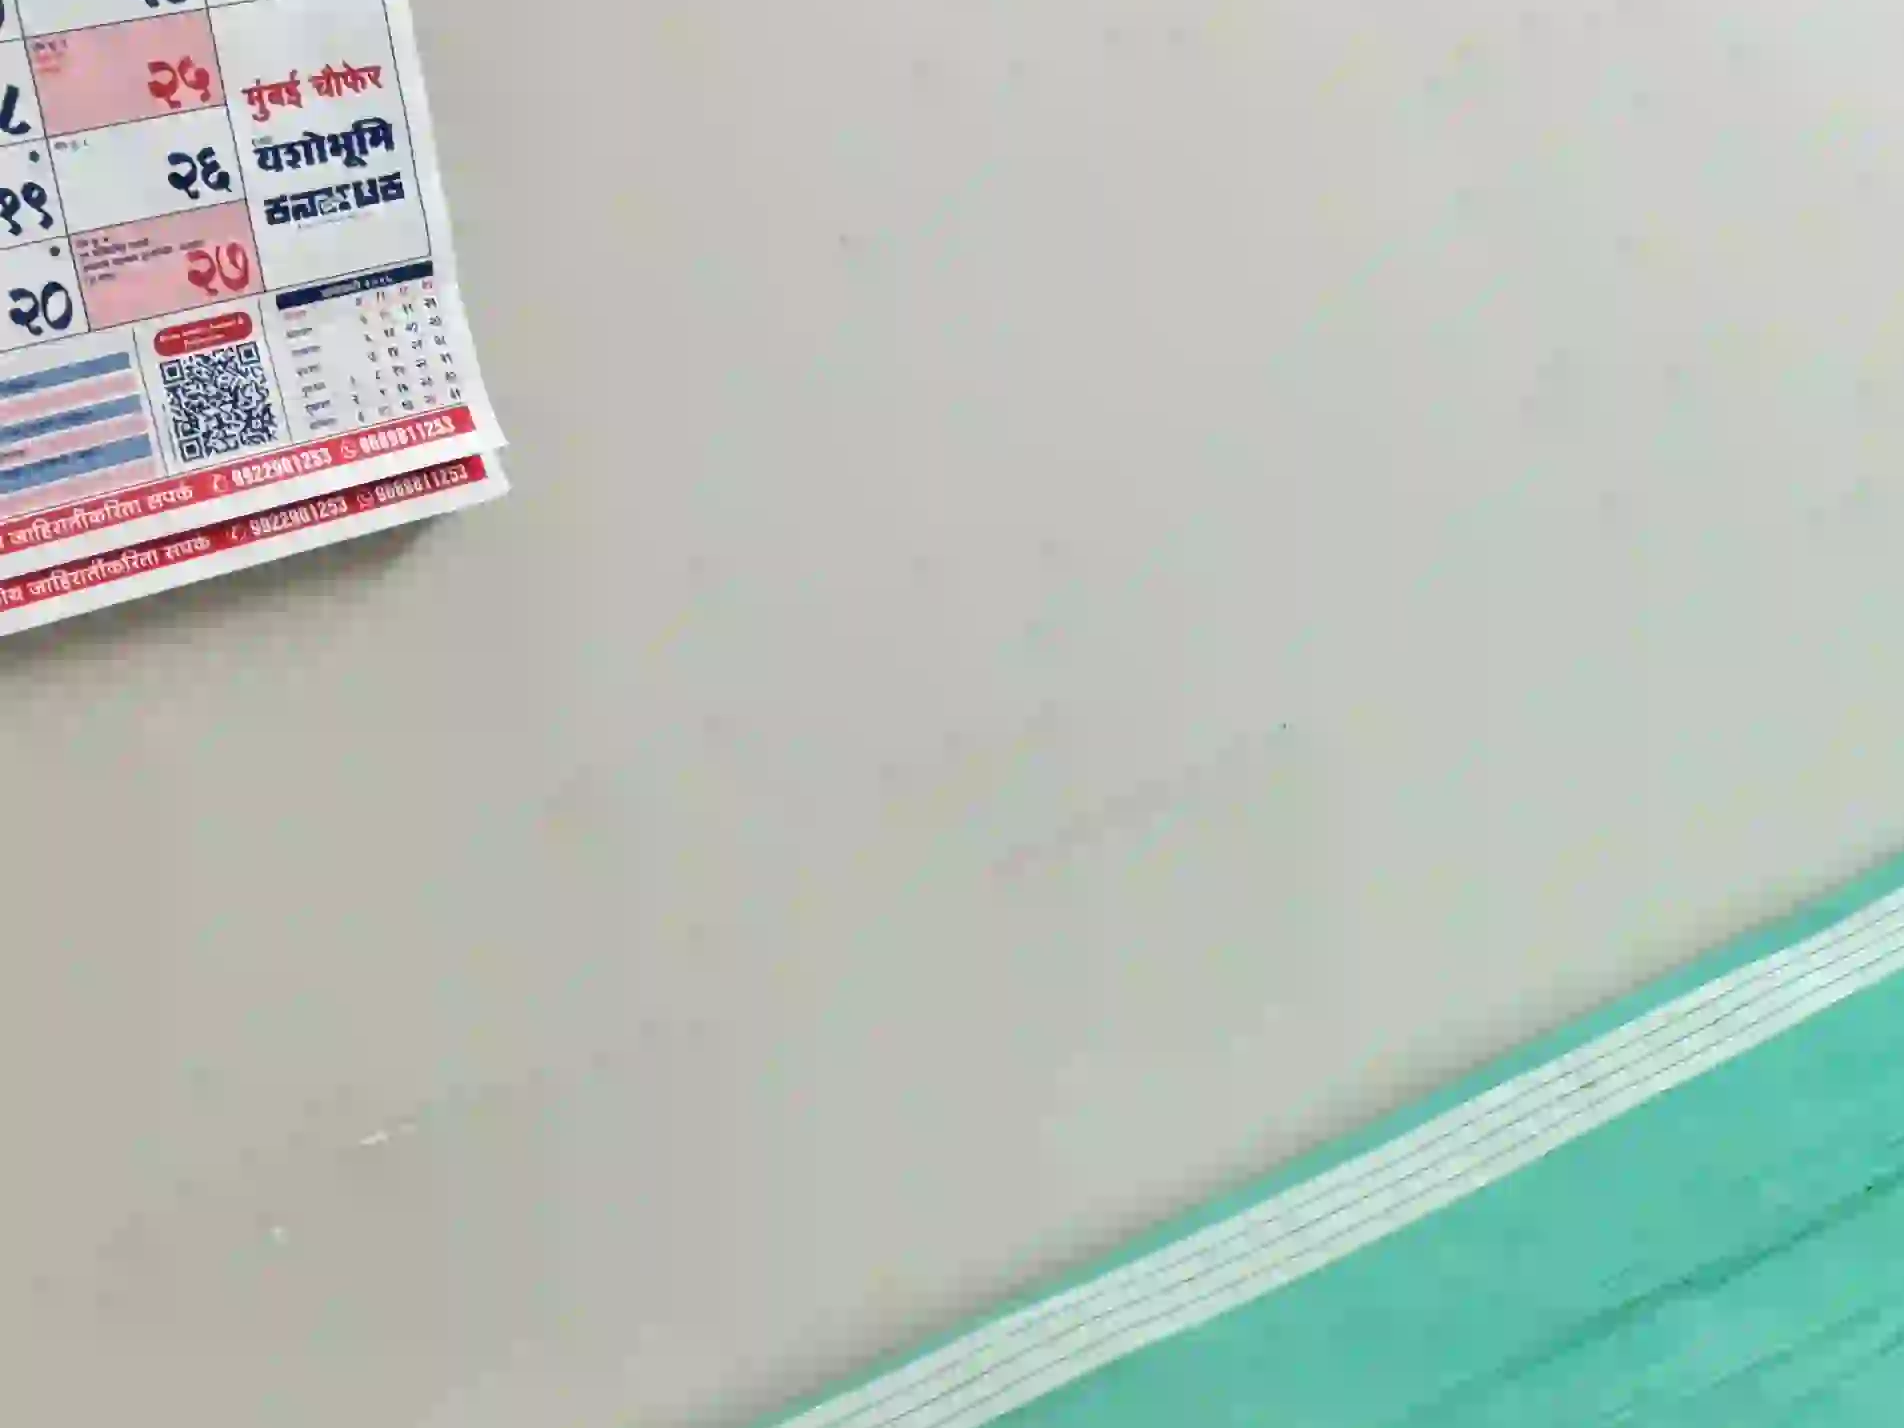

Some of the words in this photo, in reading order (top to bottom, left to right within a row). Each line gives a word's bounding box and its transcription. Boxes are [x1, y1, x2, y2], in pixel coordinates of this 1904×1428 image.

[148, 56, 210, 108] २५
[240, 69, 303, 121] मुंबई
[168, 147, 232, 199] २६
[8, 281, 73, 335] २०
[185, 242, 249, 295] २७
